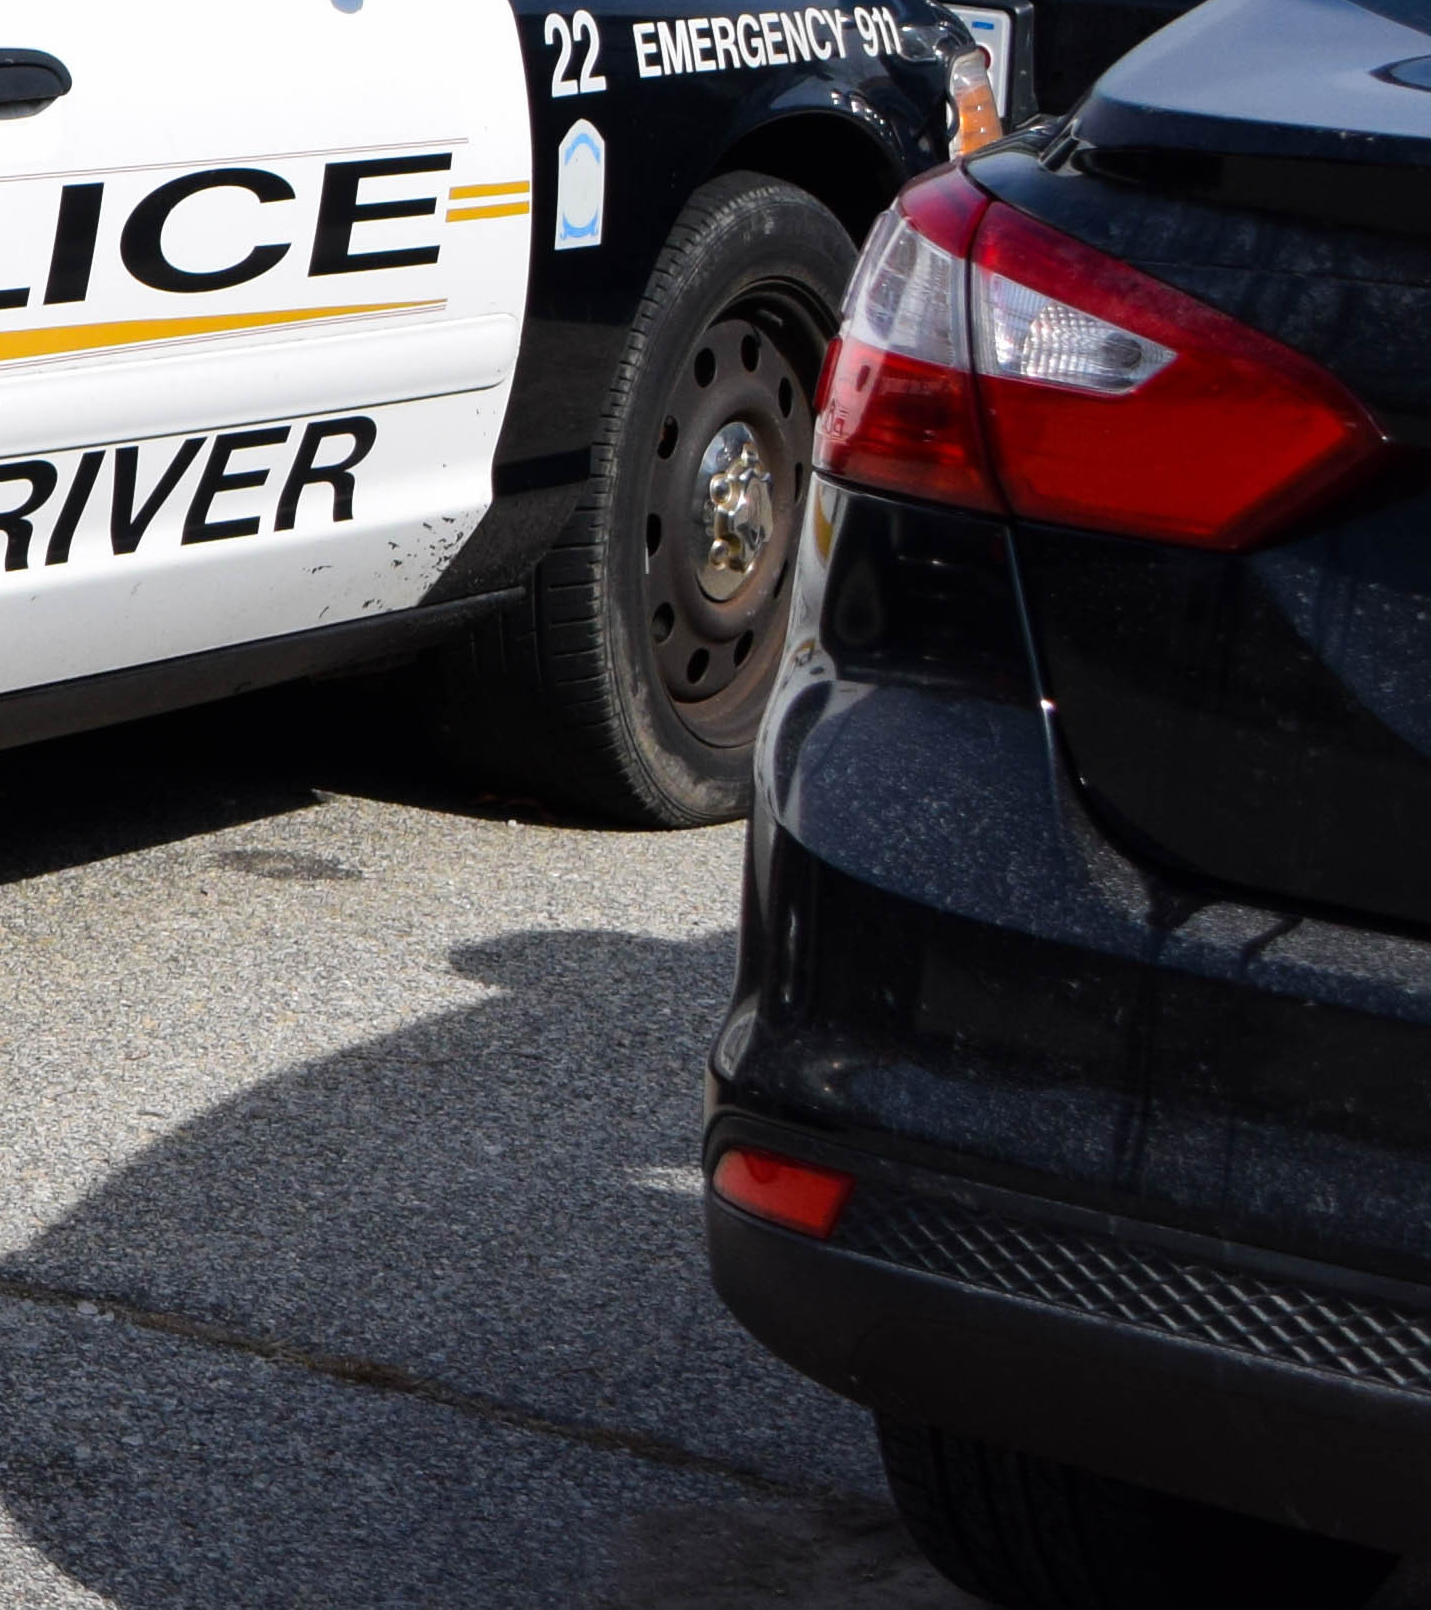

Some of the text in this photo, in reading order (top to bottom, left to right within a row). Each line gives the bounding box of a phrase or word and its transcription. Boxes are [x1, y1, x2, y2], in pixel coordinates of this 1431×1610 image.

[544, 6, 903, 98] 22 EMERGENCY 911
